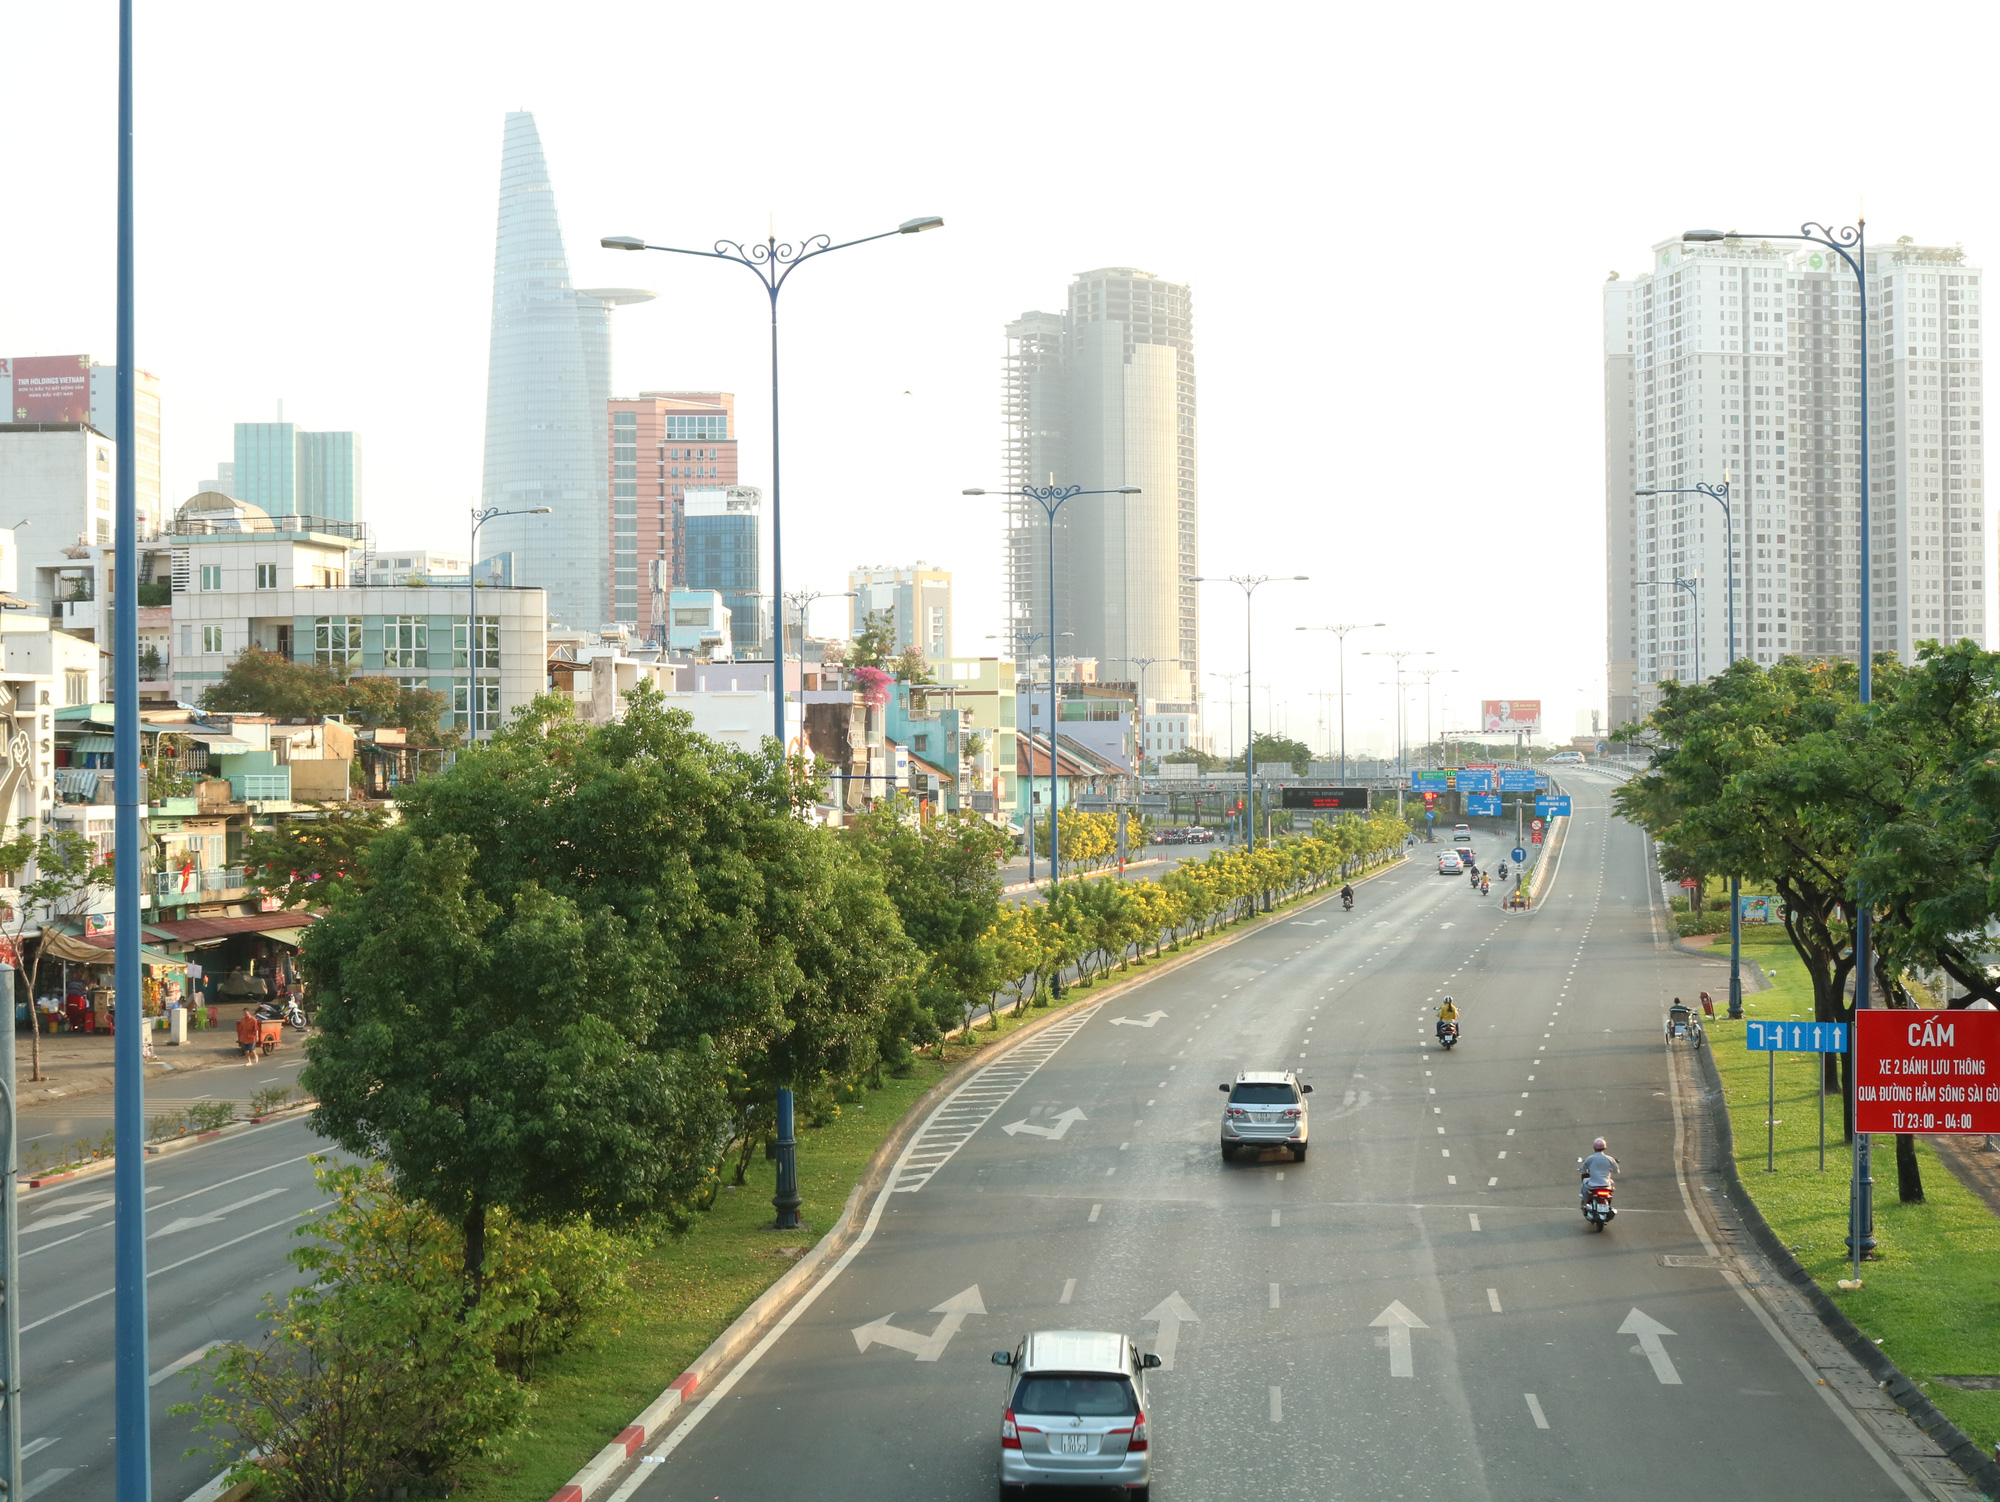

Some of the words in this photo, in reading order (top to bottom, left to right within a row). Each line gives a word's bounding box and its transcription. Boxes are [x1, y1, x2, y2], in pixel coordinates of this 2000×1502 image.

[31, 377, 59, 385] HOLDINGS
[60, 376, 85, 384] VIETNAM
[1908, 1015, 1955, 1047] CẤM
[1879, 1059, 1892, 1075] XE
[1894, 1059, 1900, 1075] 2
[1902, 1056, 1928, 1075] BÁNH
[1931, 1058, 1950, 1075] LƯU
[1953, 1057, 1985, 1075] THÔNG
[1858, 1086, 1877, 1102] QUA
[1879, 1082, 1913, 1102] ĐƯỜNG
[1915, 1081, 1936, 1102] HẦM
[1939, 1084, 1965, 1102] SÔNG
[1968, 1083, 1983, 1102] SÀI
[1986, 1083, 2000, 1102] GÒ
[1892, 1110, 1905, 1129] TỪ
[1907, 1113, 1935, 1129] 23:00
[1945, 1113, 1972, 1129] 04:00
